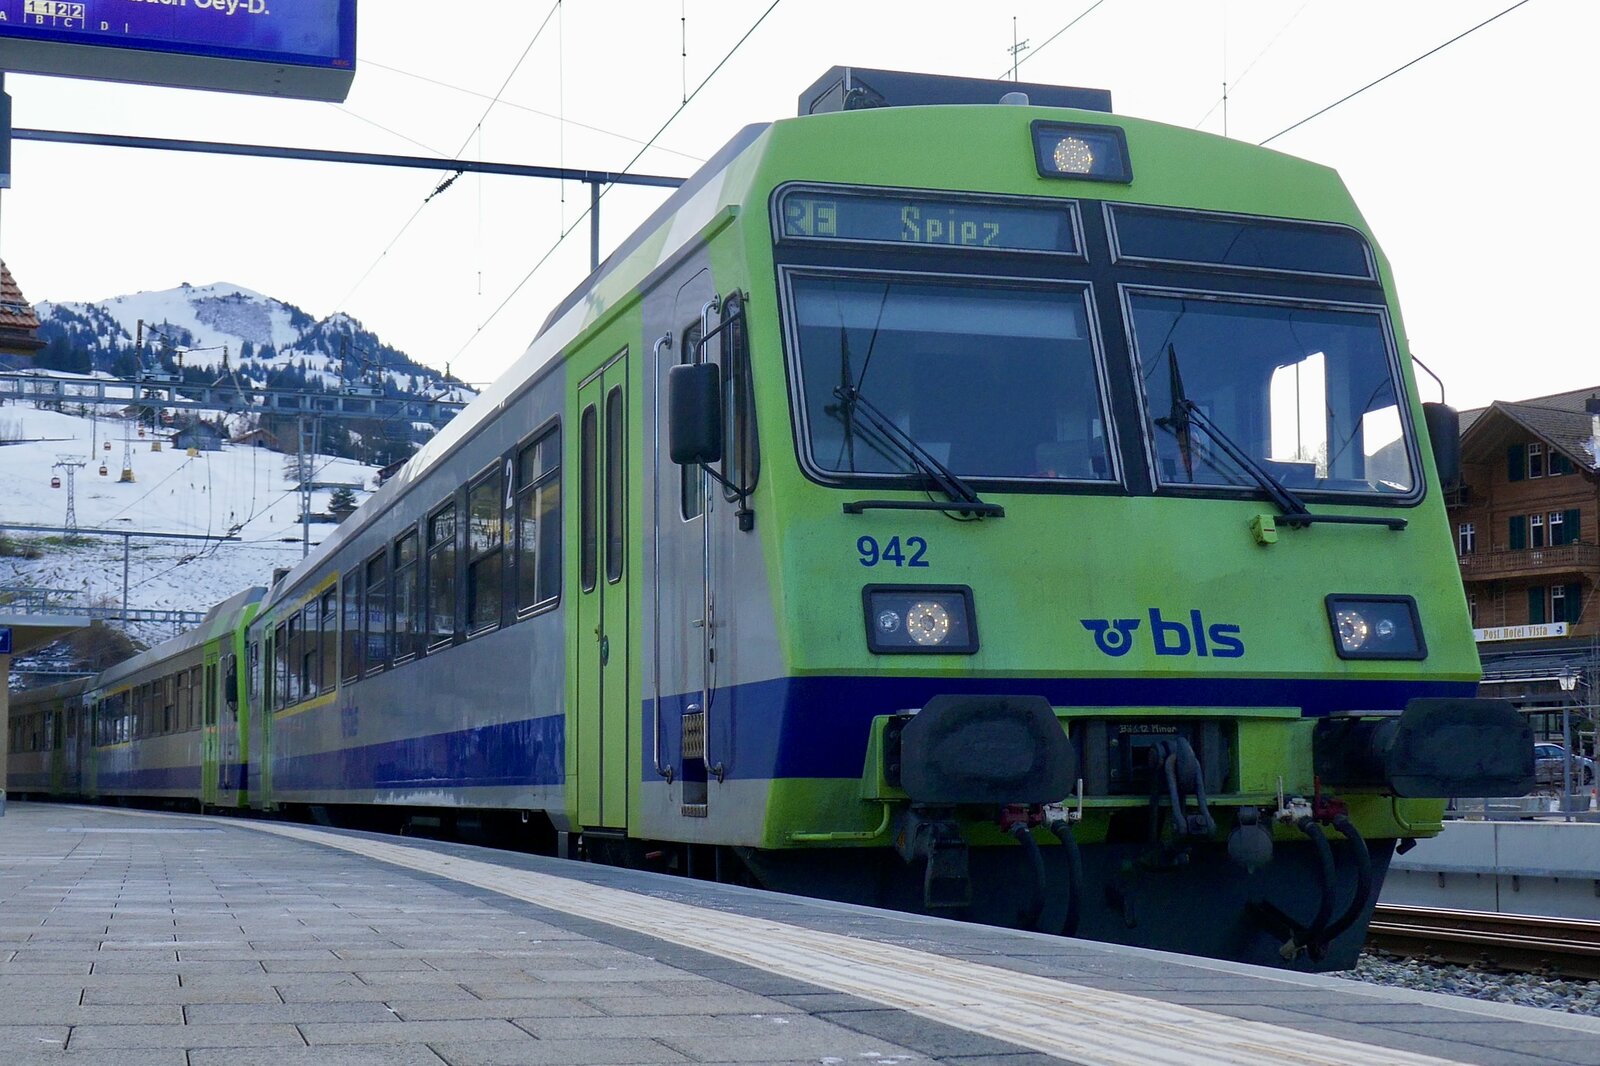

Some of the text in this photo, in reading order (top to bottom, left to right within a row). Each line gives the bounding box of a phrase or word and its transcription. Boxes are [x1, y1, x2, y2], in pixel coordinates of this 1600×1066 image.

[0, 11, 109, 31] A B C D
[901, 205, 1000, 247] Spiez
[505, 458, 514, 510] 2
[856, 535, 930, 568] 942
[1148, 607, 1245, 659] bls
[1483, 625, 1548, 640] Post Hotel Vista
